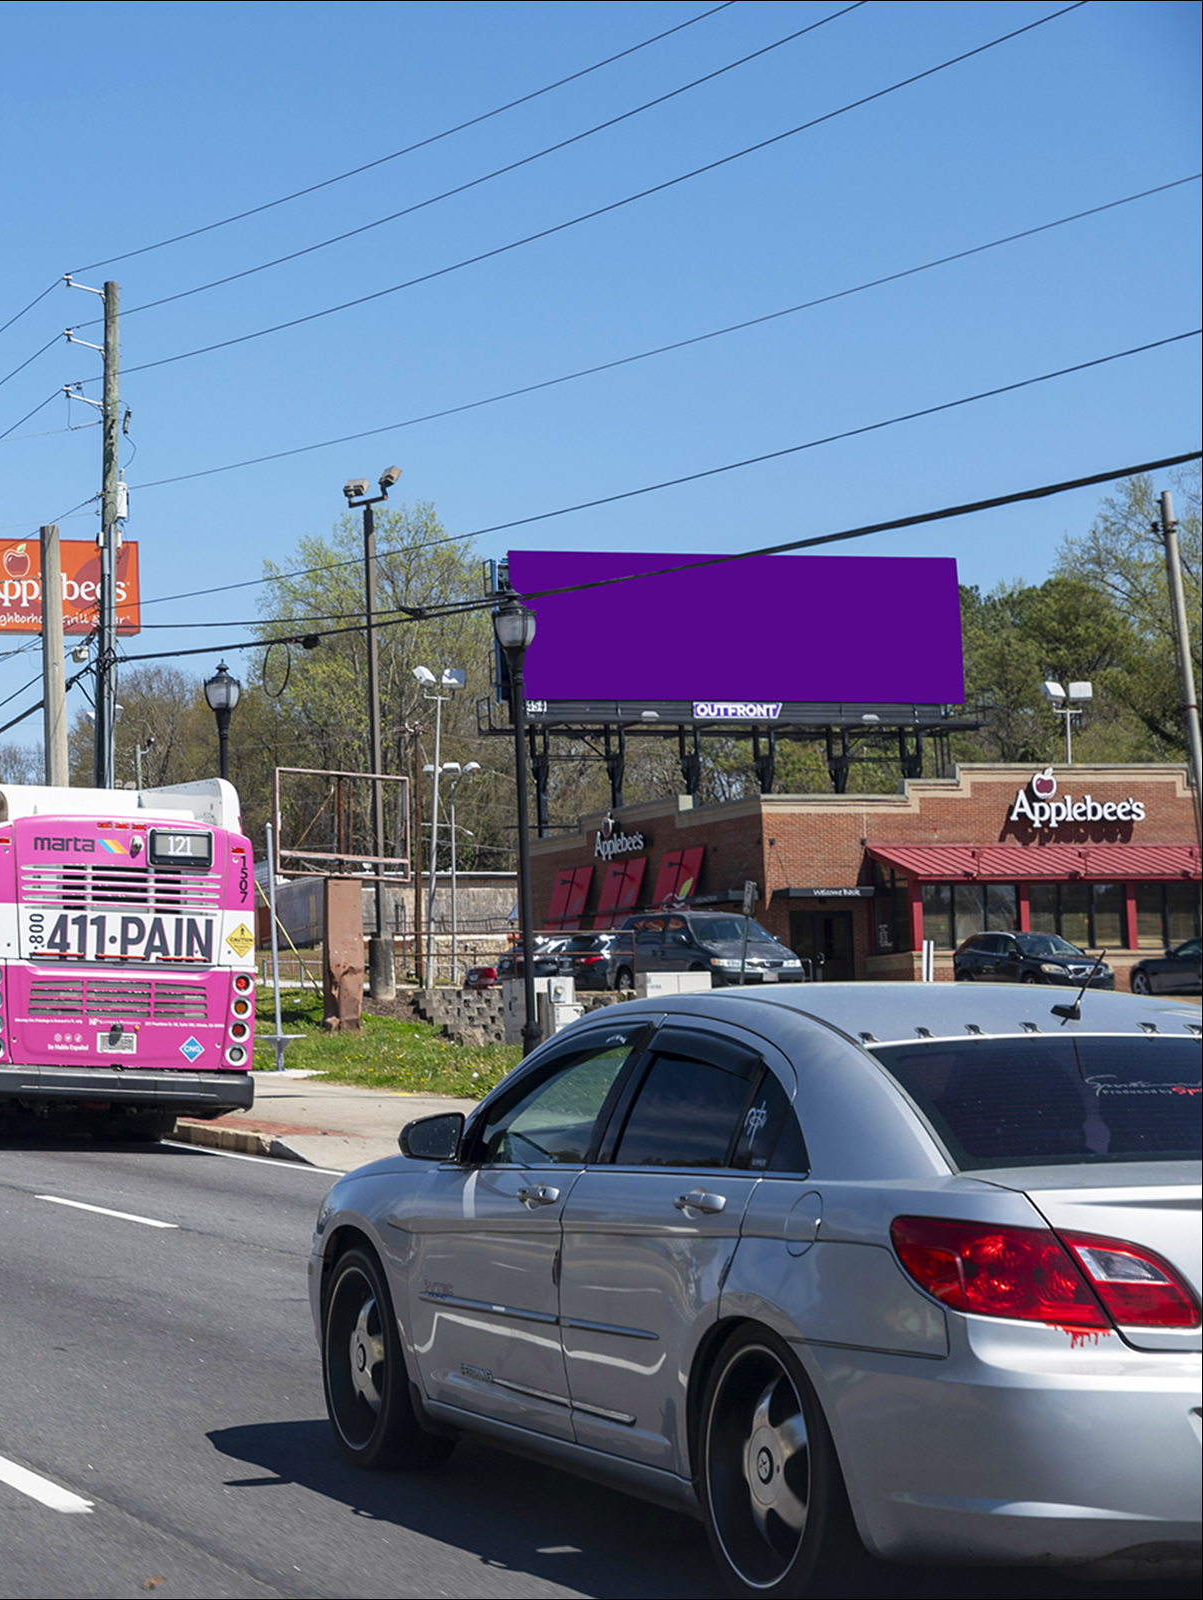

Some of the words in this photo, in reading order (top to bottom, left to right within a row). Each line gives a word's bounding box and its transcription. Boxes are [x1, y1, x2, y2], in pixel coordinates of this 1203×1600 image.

[697, 703, 776, 717] OUTFRONT
[1010, 789, 1146, 828] Applebee's
[34, 836, 95, 852] marta
[167, 836, 193, 856] 121
[594, 831, 645, 861] Applebee's
[240, 855, 249, 903] 1507
[183, 1045, 201, 1053] CNG
